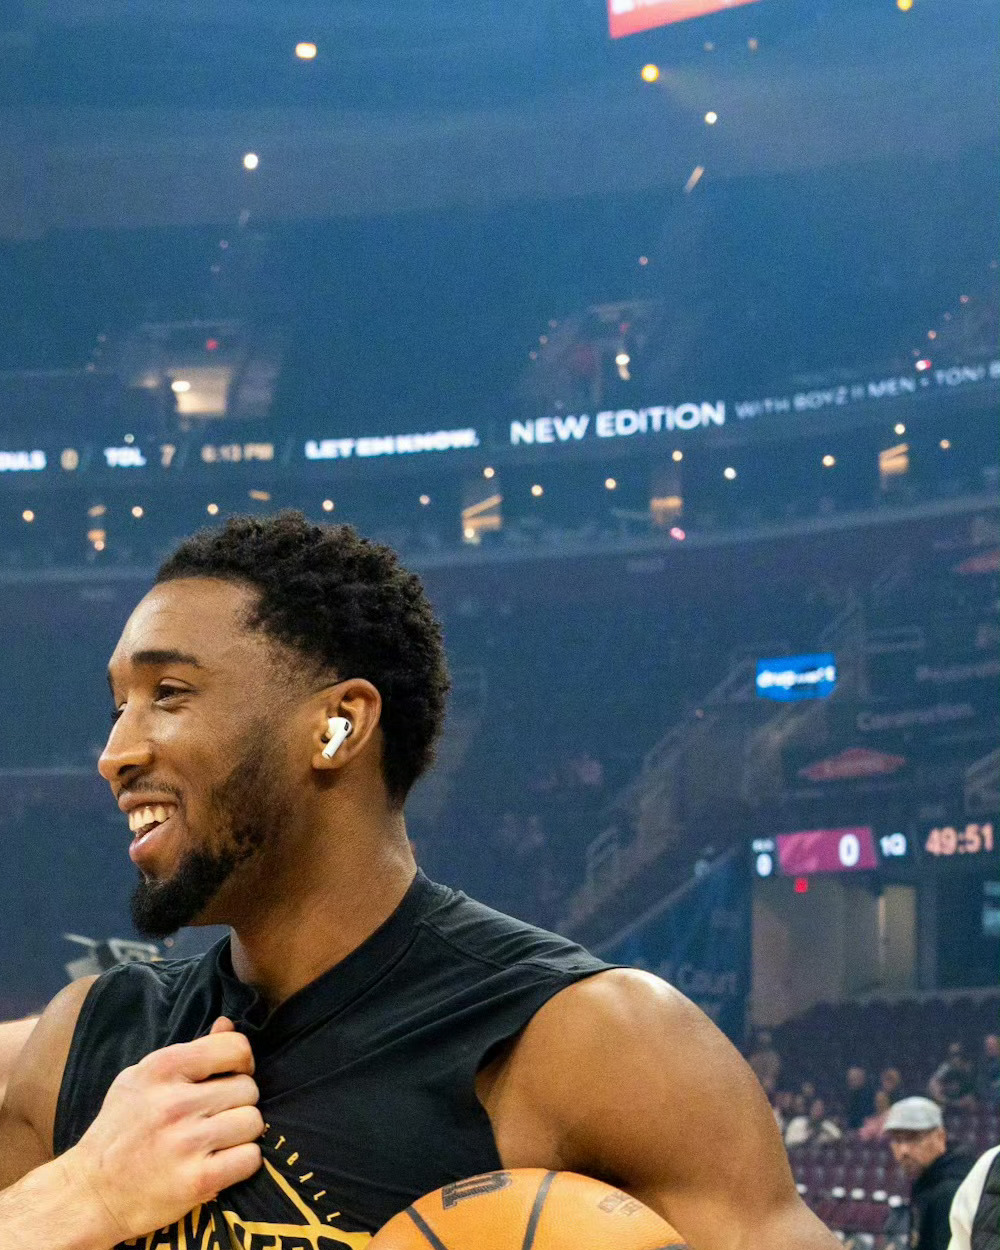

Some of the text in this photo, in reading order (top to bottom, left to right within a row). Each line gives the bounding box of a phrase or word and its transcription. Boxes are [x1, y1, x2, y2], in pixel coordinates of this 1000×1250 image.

[511, 414, 590, 445] NEW
[595, 401, 726, 438] EDITION
[735, 399, 790, 420] WITH
[867, 377, 916, 399] MEN
[60, 448, 79, 471] 0
[304, 438, 354, 460] LET
[757, 853, 772, 877] 0
[838, 833, 860, 867] 0
[925, 823, 993, 856] 49:51
